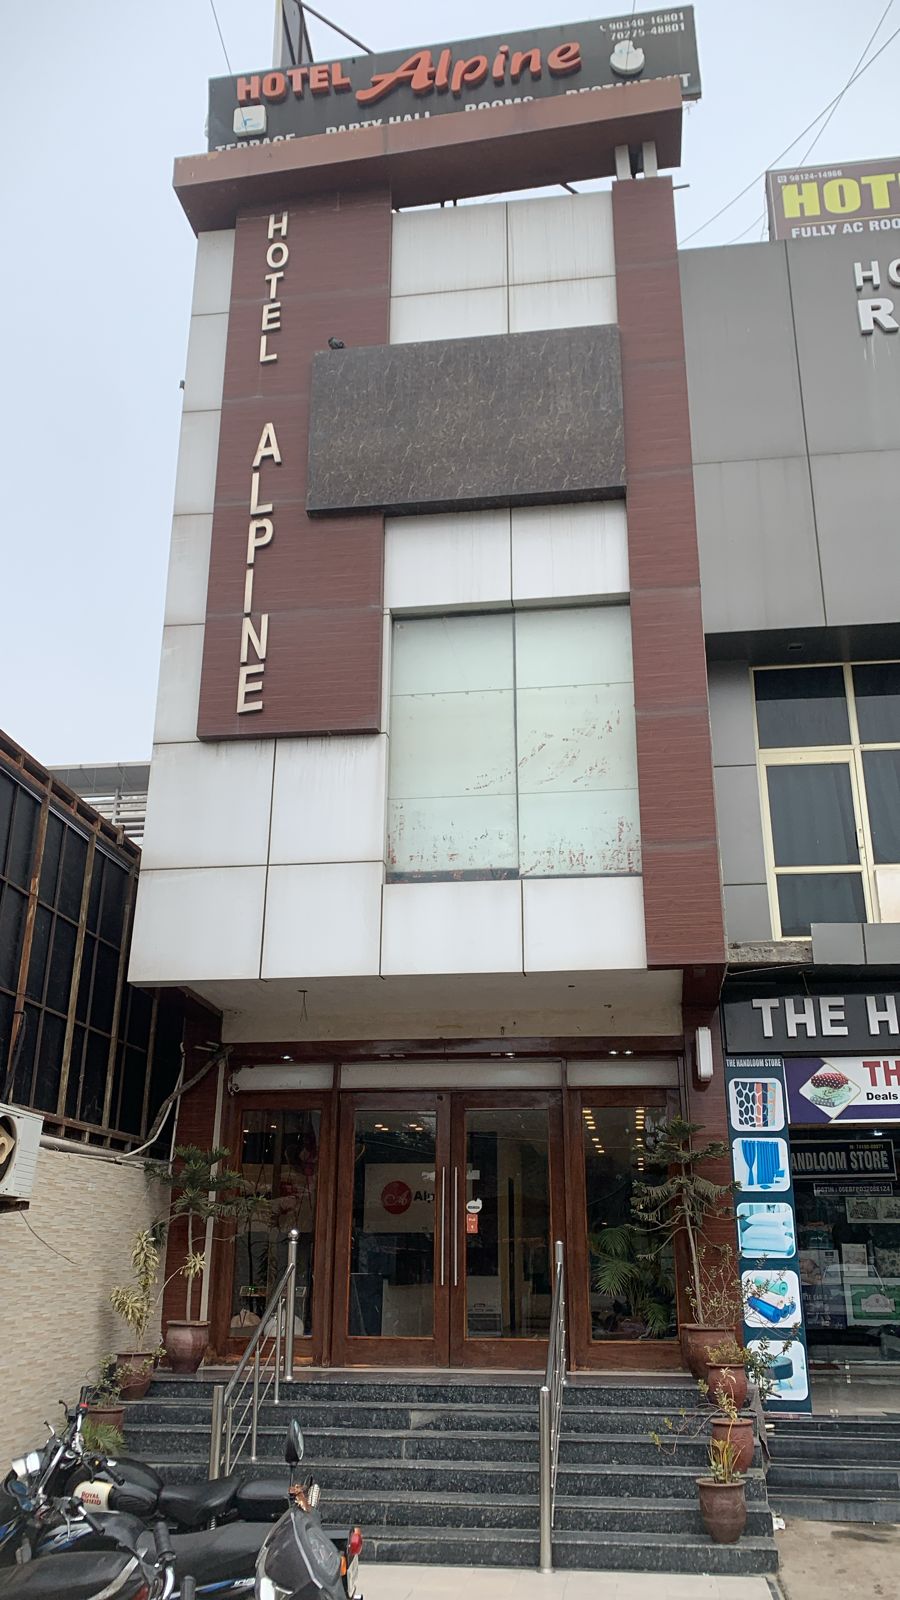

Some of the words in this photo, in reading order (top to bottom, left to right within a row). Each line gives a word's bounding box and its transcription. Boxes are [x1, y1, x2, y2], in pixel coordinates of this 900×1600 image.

[237, 63, 352, 100] HOTEL
[355, 40, 582, 102] Alpine
[781, 173, 900, 218] HOT
[791, 224, 837, 239] FULLY
[842, 221, 864, 234] AC
[259, 211, 290, 364] HOTEL
[857, 298, 900, 334] R
[235, 422, 283, 715] ALPINE
[752, 996, 849, 1038] THE
[866, 995, 900, 1036] H
[726, 1058, 736, 1067] THE
[736, 1058, 764, 1067] HANDLOOM
[764, 1058, 781, 1067] STORE
[863, 1060, 900, 1087] TH
[866, 1092, 899, 1100] Deals
[850, 1150, 889, 1169] STORE
